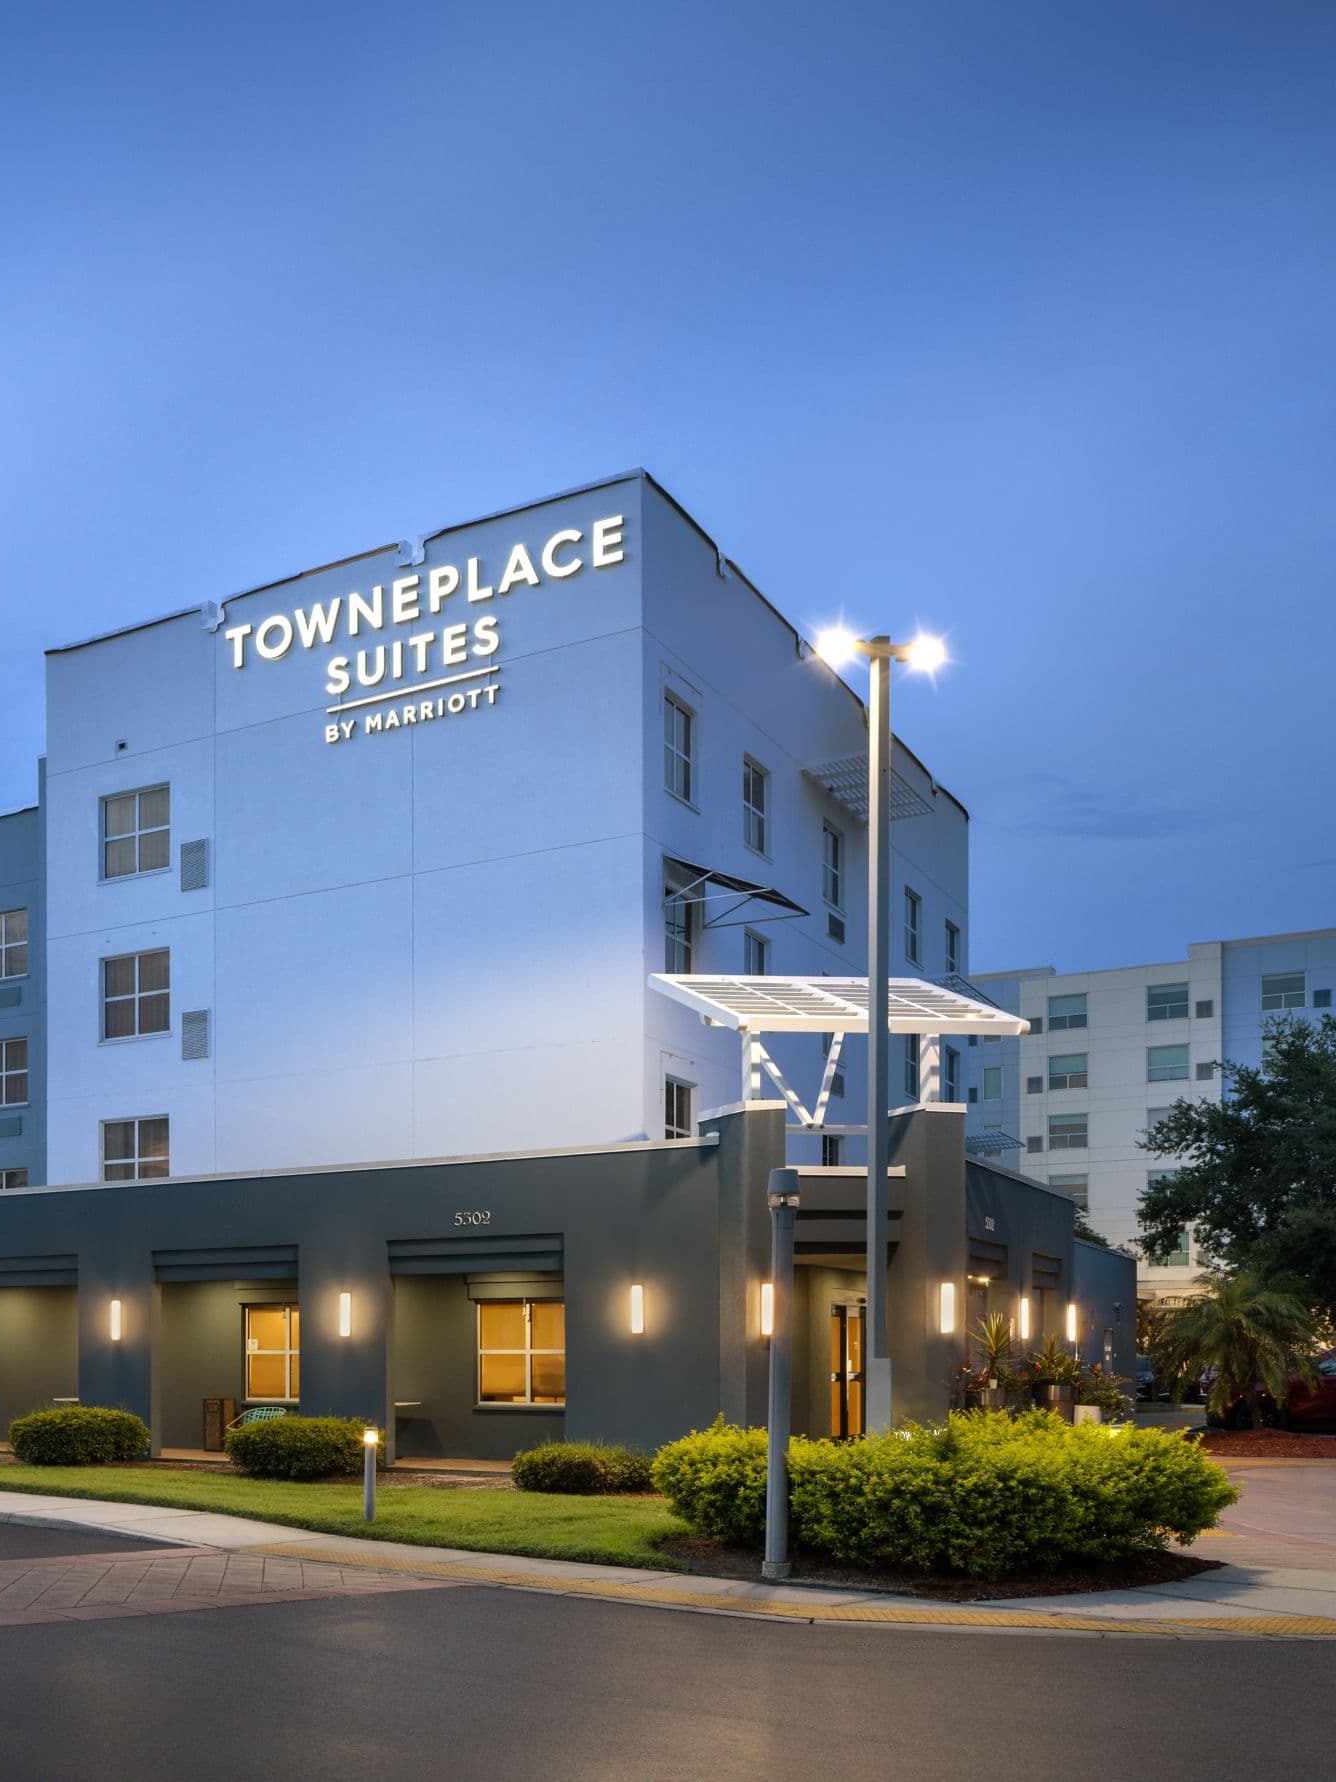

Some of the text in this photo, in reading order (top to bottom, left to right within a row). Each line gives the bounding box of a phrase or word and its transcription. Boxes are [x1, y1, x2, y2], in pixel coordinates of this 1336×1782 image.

[225, 514, 625, 668] TOWNEPLACE
[326, 616, 500, 694] SUITES
[325, 684, 500, 743] BY MARRIOTT
[454, 1210, 491, 1226] 5302
